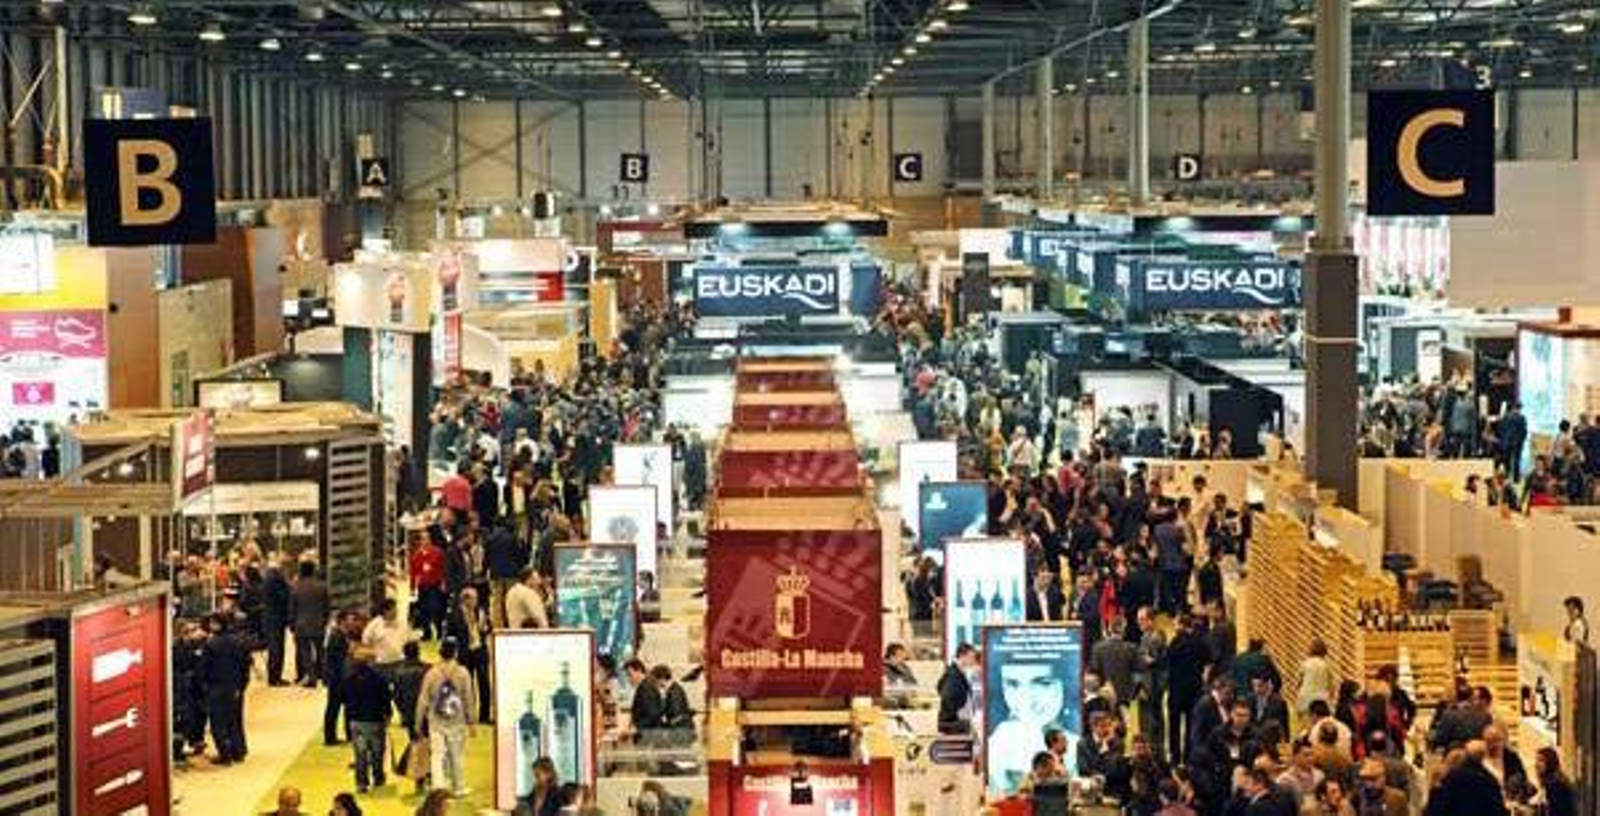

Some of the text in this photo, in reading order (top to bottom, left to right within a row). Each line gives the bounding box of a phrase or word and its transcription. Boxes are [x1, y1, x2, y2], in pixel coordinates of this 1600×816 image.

[1397, 108, 1465, 197] C
[367, 162, 386, 184] A
[627, 158, 642, 179] B
[899, 156, 917, 179] C
[1180, 157, 1198, 179] D
[117, 139, 182, 226] B
[698, 273, 835, 298] EUSKADI
[1146, 267, 1286, 292] EUSKADI
[721, 649, 864, 669] Castilla-La Mancha
